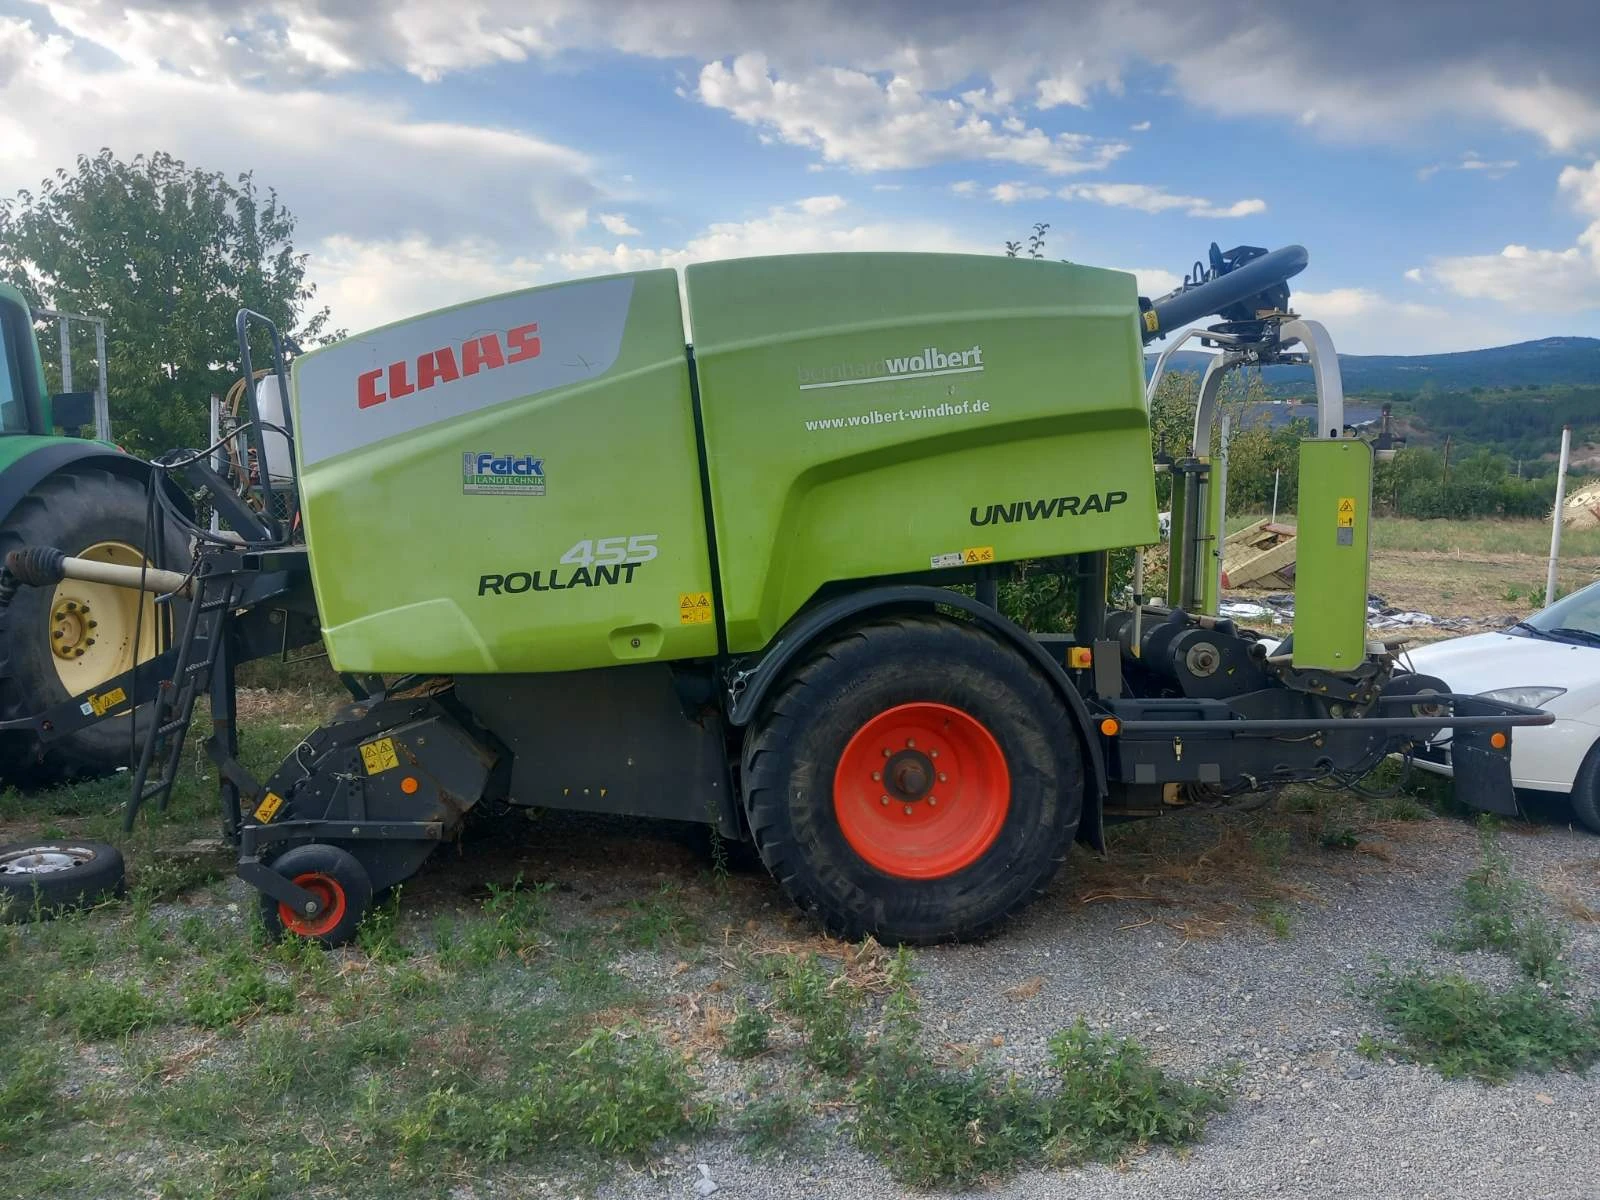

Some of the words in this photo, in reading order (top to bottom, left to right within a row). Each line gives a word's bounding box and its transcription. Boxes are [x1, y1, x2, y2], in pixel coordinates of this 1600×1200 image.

[358, 323, 540, 409] CLAAS
[886, 345, 983, 373] wolbert
[805, 400, 990, 431] www.wolbert-windhof.de
[477, 453, 544, 476] Feick
[477, 475, 544, 485] LANDTECHNIK
[970, 491, 1127, 526] UNIWRAP
[560, 534, 658, 567] 455
[478, 562, 642, 596] ROLLANT
